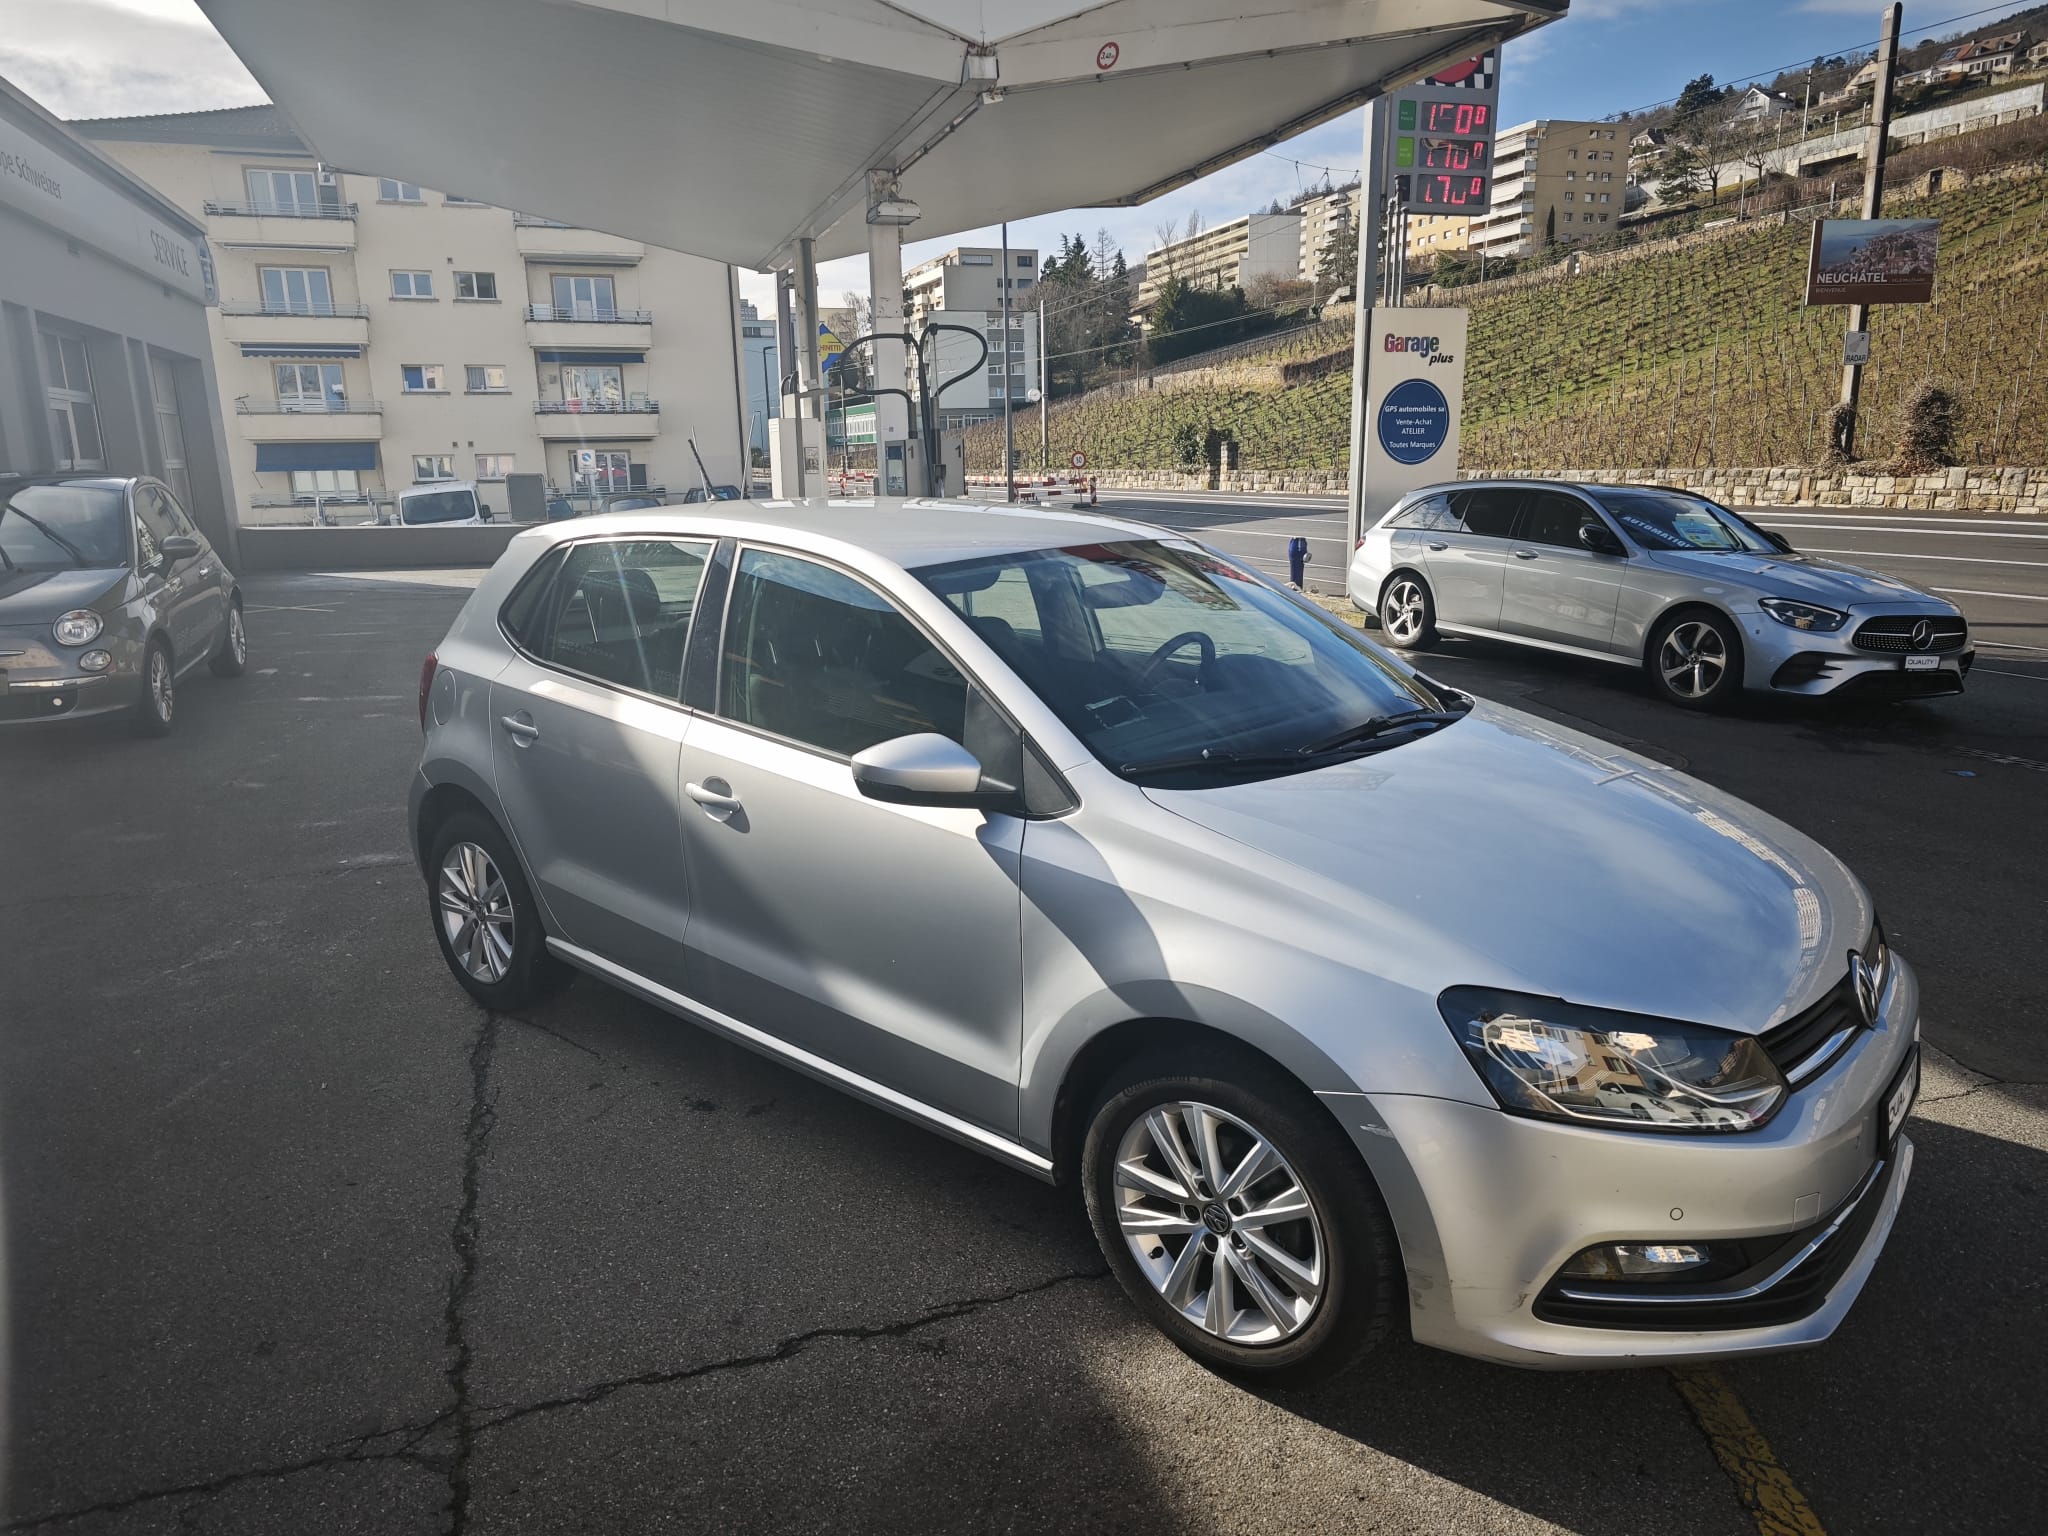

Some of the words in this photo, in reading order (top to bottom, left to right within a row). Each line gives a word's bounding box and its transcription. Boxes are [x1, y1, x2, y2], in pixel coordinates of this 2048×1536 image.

[15, 155, 62, 200] Schweizer
[150, 229, 190, 277] SERVICE
[1816, 269, 1888, 284] NEUCHÂTEL
[1384, 333, 1440, 358] Garage
[1428, 352, 1454, 367] plus
[1846, 354, 1867, 362] RADAR
[1384, 405, 1398, 413] GPS
[1398, 405, 1437, 413] automobiles
[1395, 418, 1433, 426] Vente-Achat
[955, 444, 962, 459] 1
[1389, 441, 1409, 449] Toutes
[1409, 441, 1436, 450] Marques
